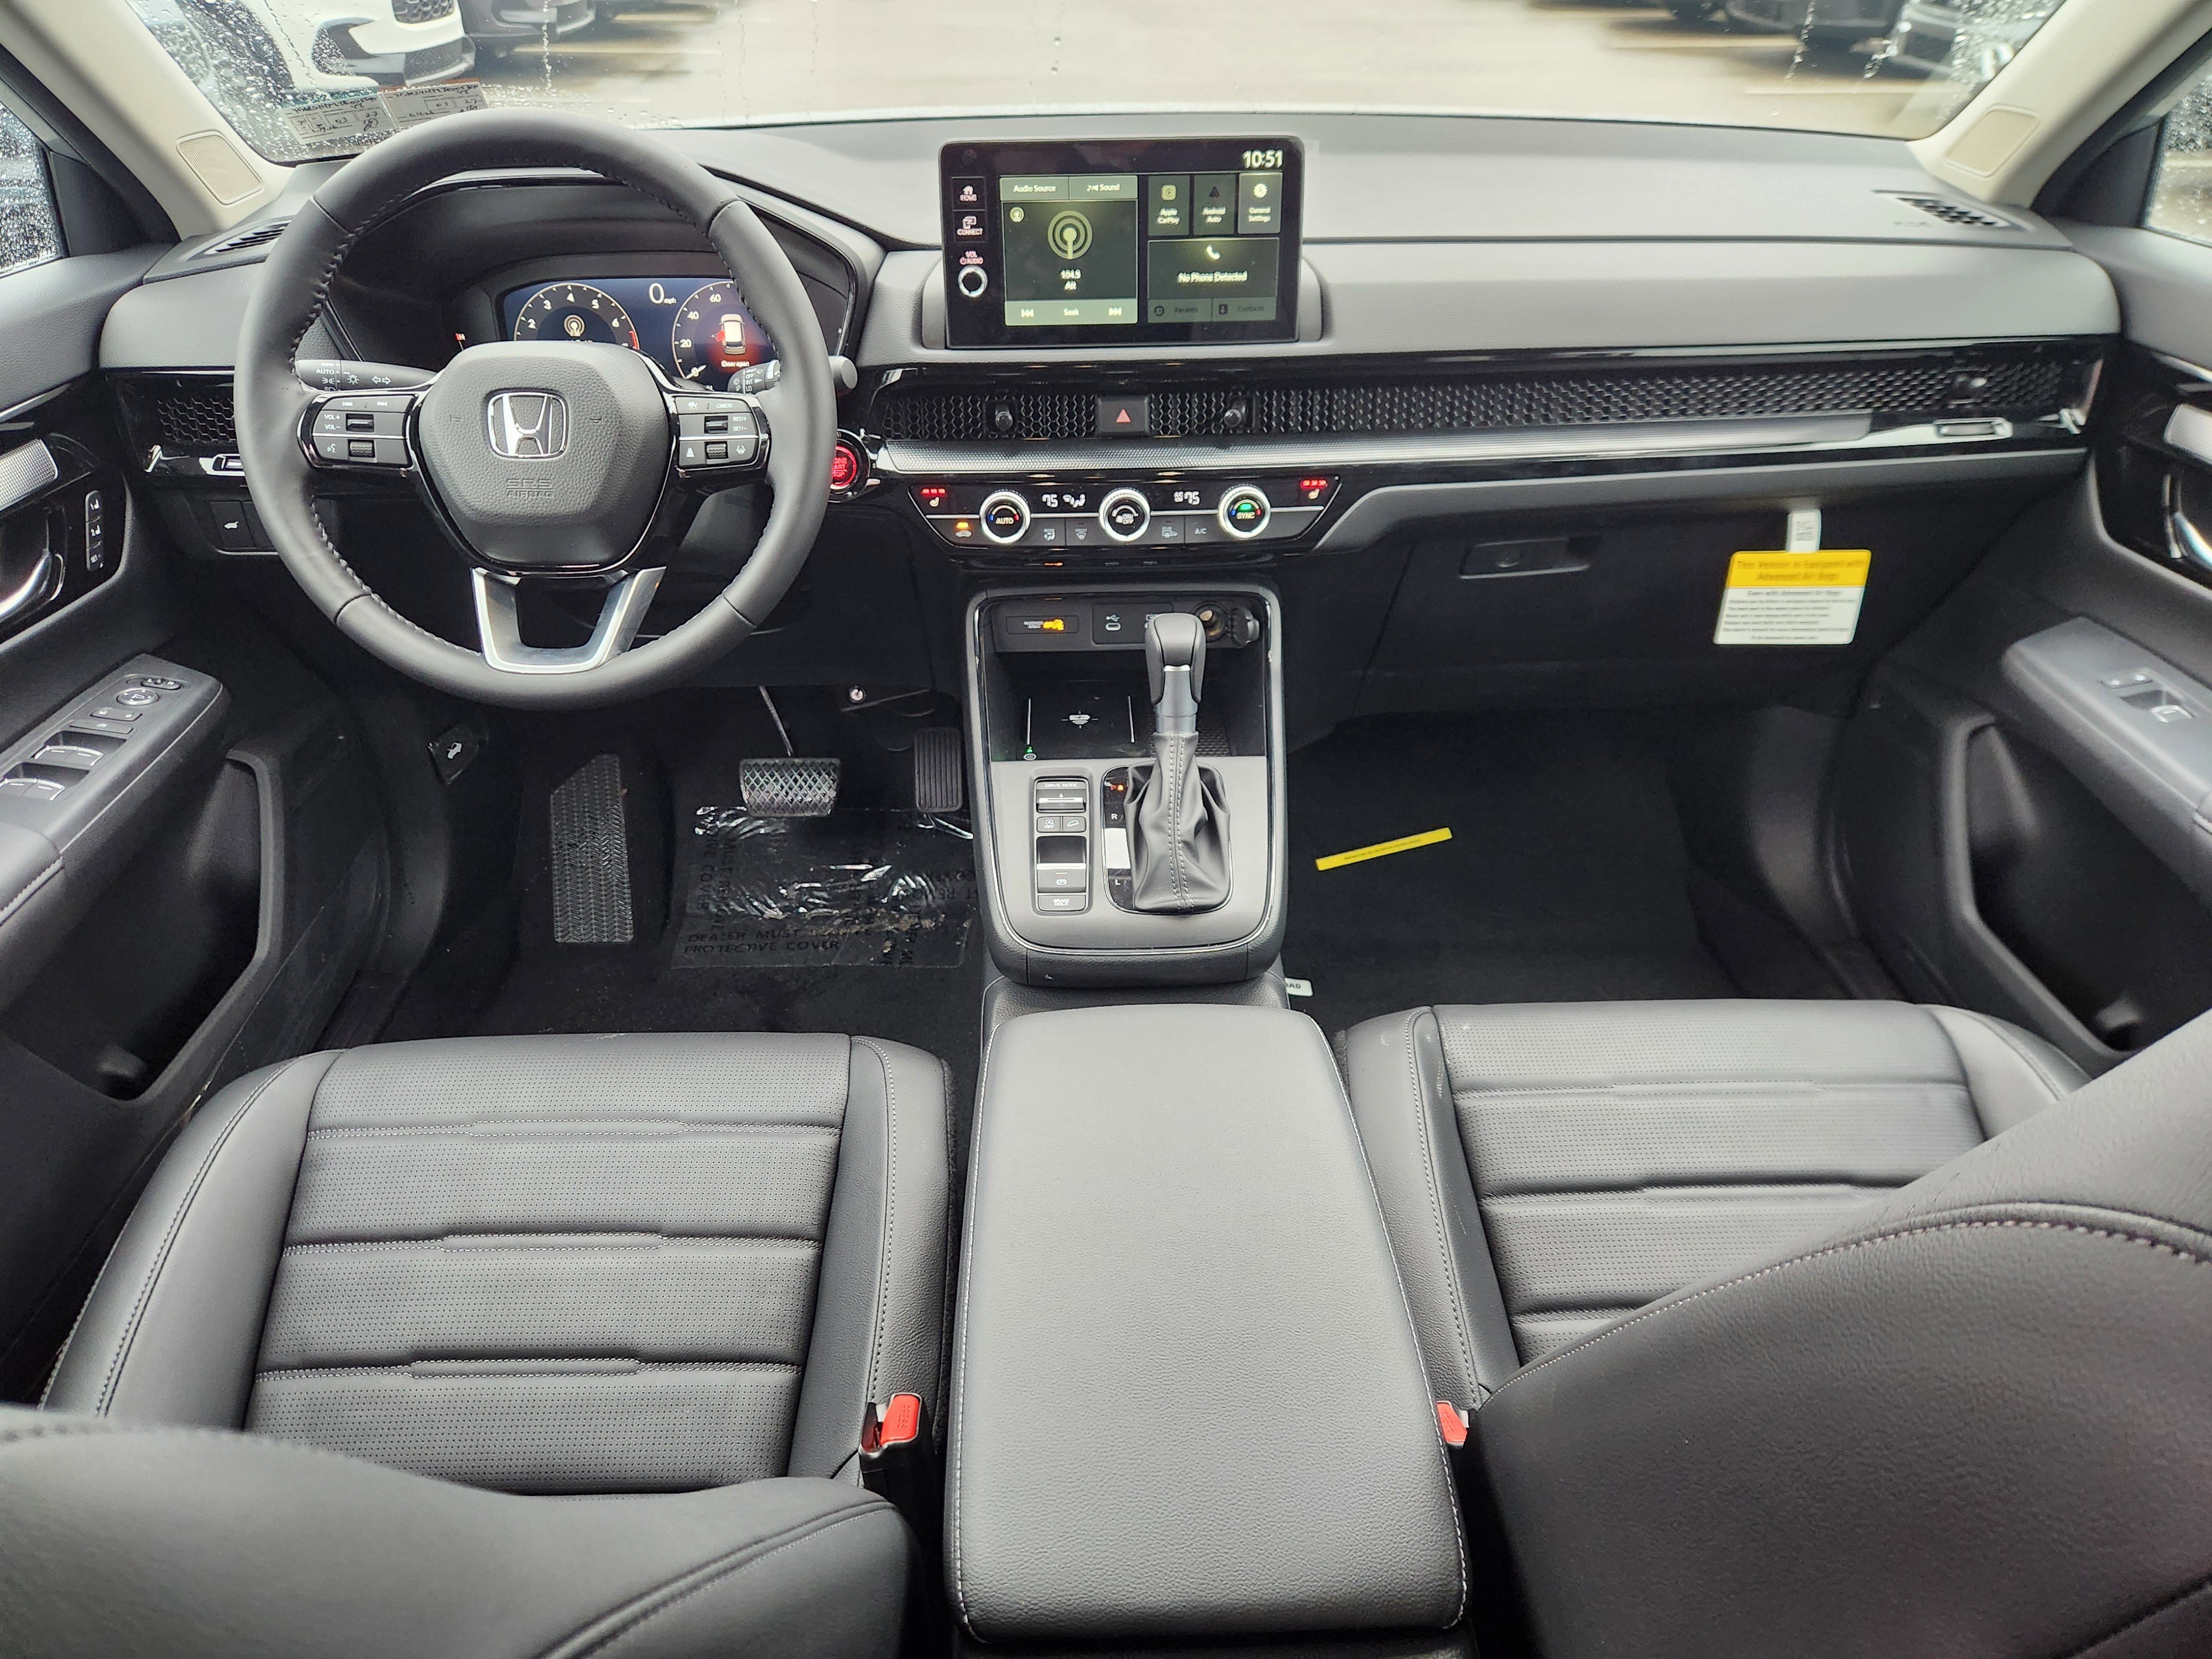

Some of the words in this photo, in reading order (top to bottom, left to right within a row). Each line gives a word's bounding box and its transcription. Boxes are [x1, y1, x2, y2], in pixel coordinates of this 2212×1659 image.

[1242, 149, 1283, 168] 10:51
[1013, 185, 1033, 193] Audio
[1034, 184, 1056, 192] Source
[1099, 183, 1120, 191] Sound
[956, 227, 983, 236] CONNECT
[1177, 271, 1191, 283] No
[1191, 270, 1214, 283] Phone
[1213, 270, 1248, 283] Detected
[566, 292, 575, 303] 4
[649, 283, 664, 304] 0
[664, 296, 677, 305] mph
[709, 293, 722, 303] 60
[543, 299, 552, 311] 3
[591, 299, 600, 310] 5
[687, 311, 700, 320] 40
[1063, 307, 1080, 316] Seek
[527, 318, 537, 330] 2
[611, 317, 620, 328] 6
[680, 338, 692, 348] 20
[721, 359, 737, 368] Door
[736, 360, 750, 368] open
[506, 489, 552, 498] AIRBAG
[1183, 491, 1200, 505] 75
[1041, 493, 1058, 508] 75
[1236, 511, 1256, 520] SYNC
[688, 931, 745, 942] DEALER
[755, 928, 800, 939] MUST
[684, 942, 776, 954] PROTECTIVE
[786, 941, 839, 951] COVER
